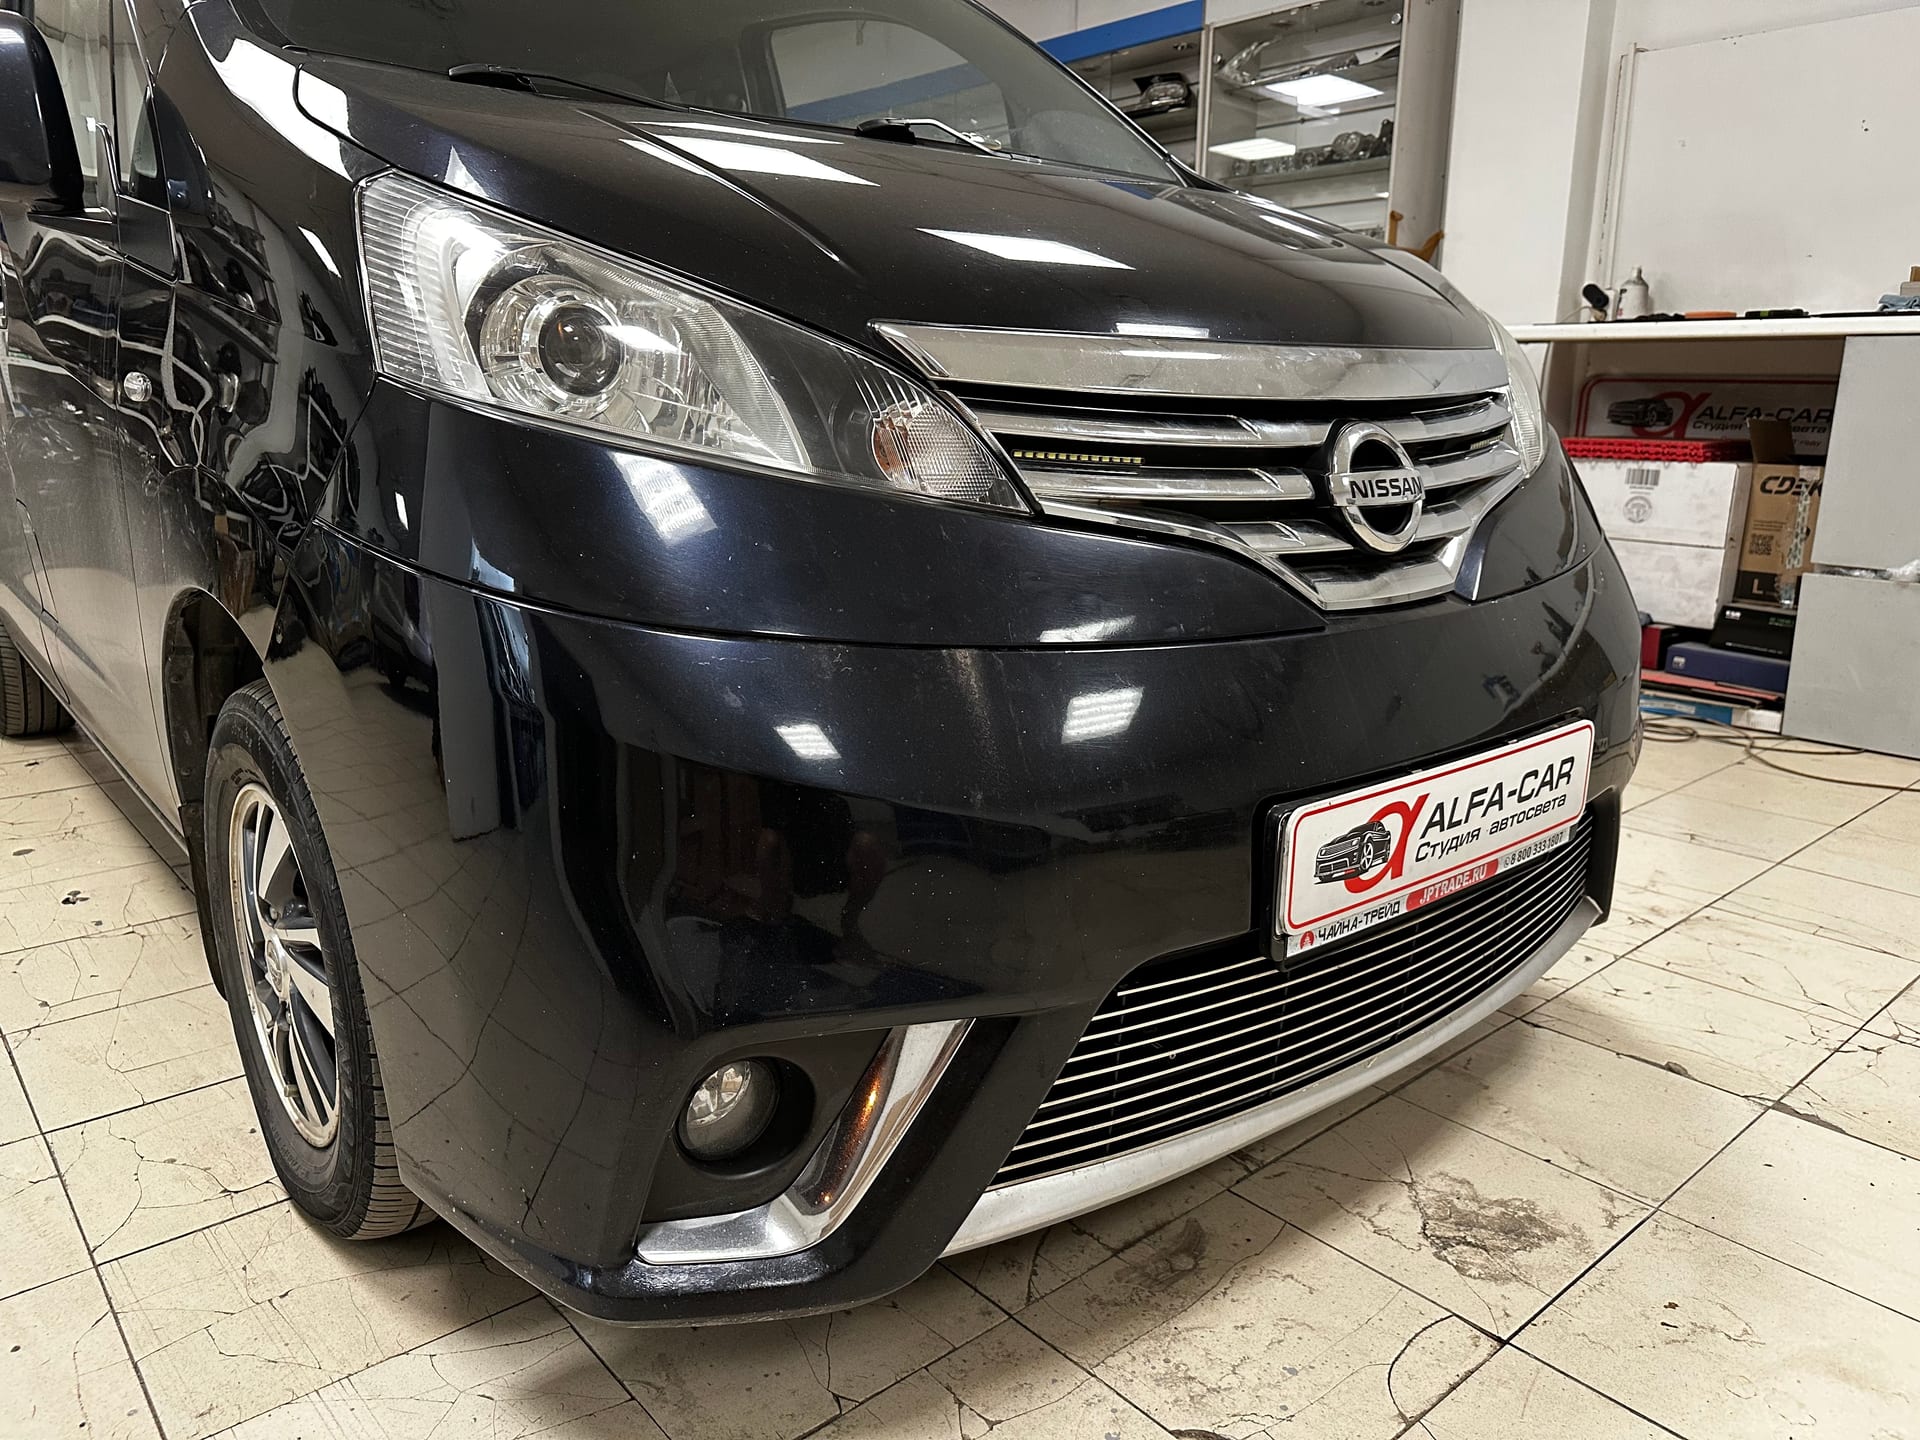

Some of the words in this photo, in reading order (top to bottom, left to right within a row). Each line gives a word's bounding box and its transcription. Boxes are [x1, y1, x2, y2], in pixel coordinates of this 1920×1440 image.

[1696, 406, 1833, 423] ALFA-CAR
[1350, 476, 1422, 499] NISSAN
[1419, 756, 1575, 840] ALFA-CAR
[1415, 827, 1481, 863] Студия
[1489, 794, 1567, 836] автосвета
[1510, 853, 1517, 865] 8
[1516, 846, 1532, 862] 800
[1532, 839, 1547, 856] 333
[1419, 864, 1488, 905] JPTRADE.RU
[1318, 899, 1401, 942] ЧАЙНА-ТРЕЙД
